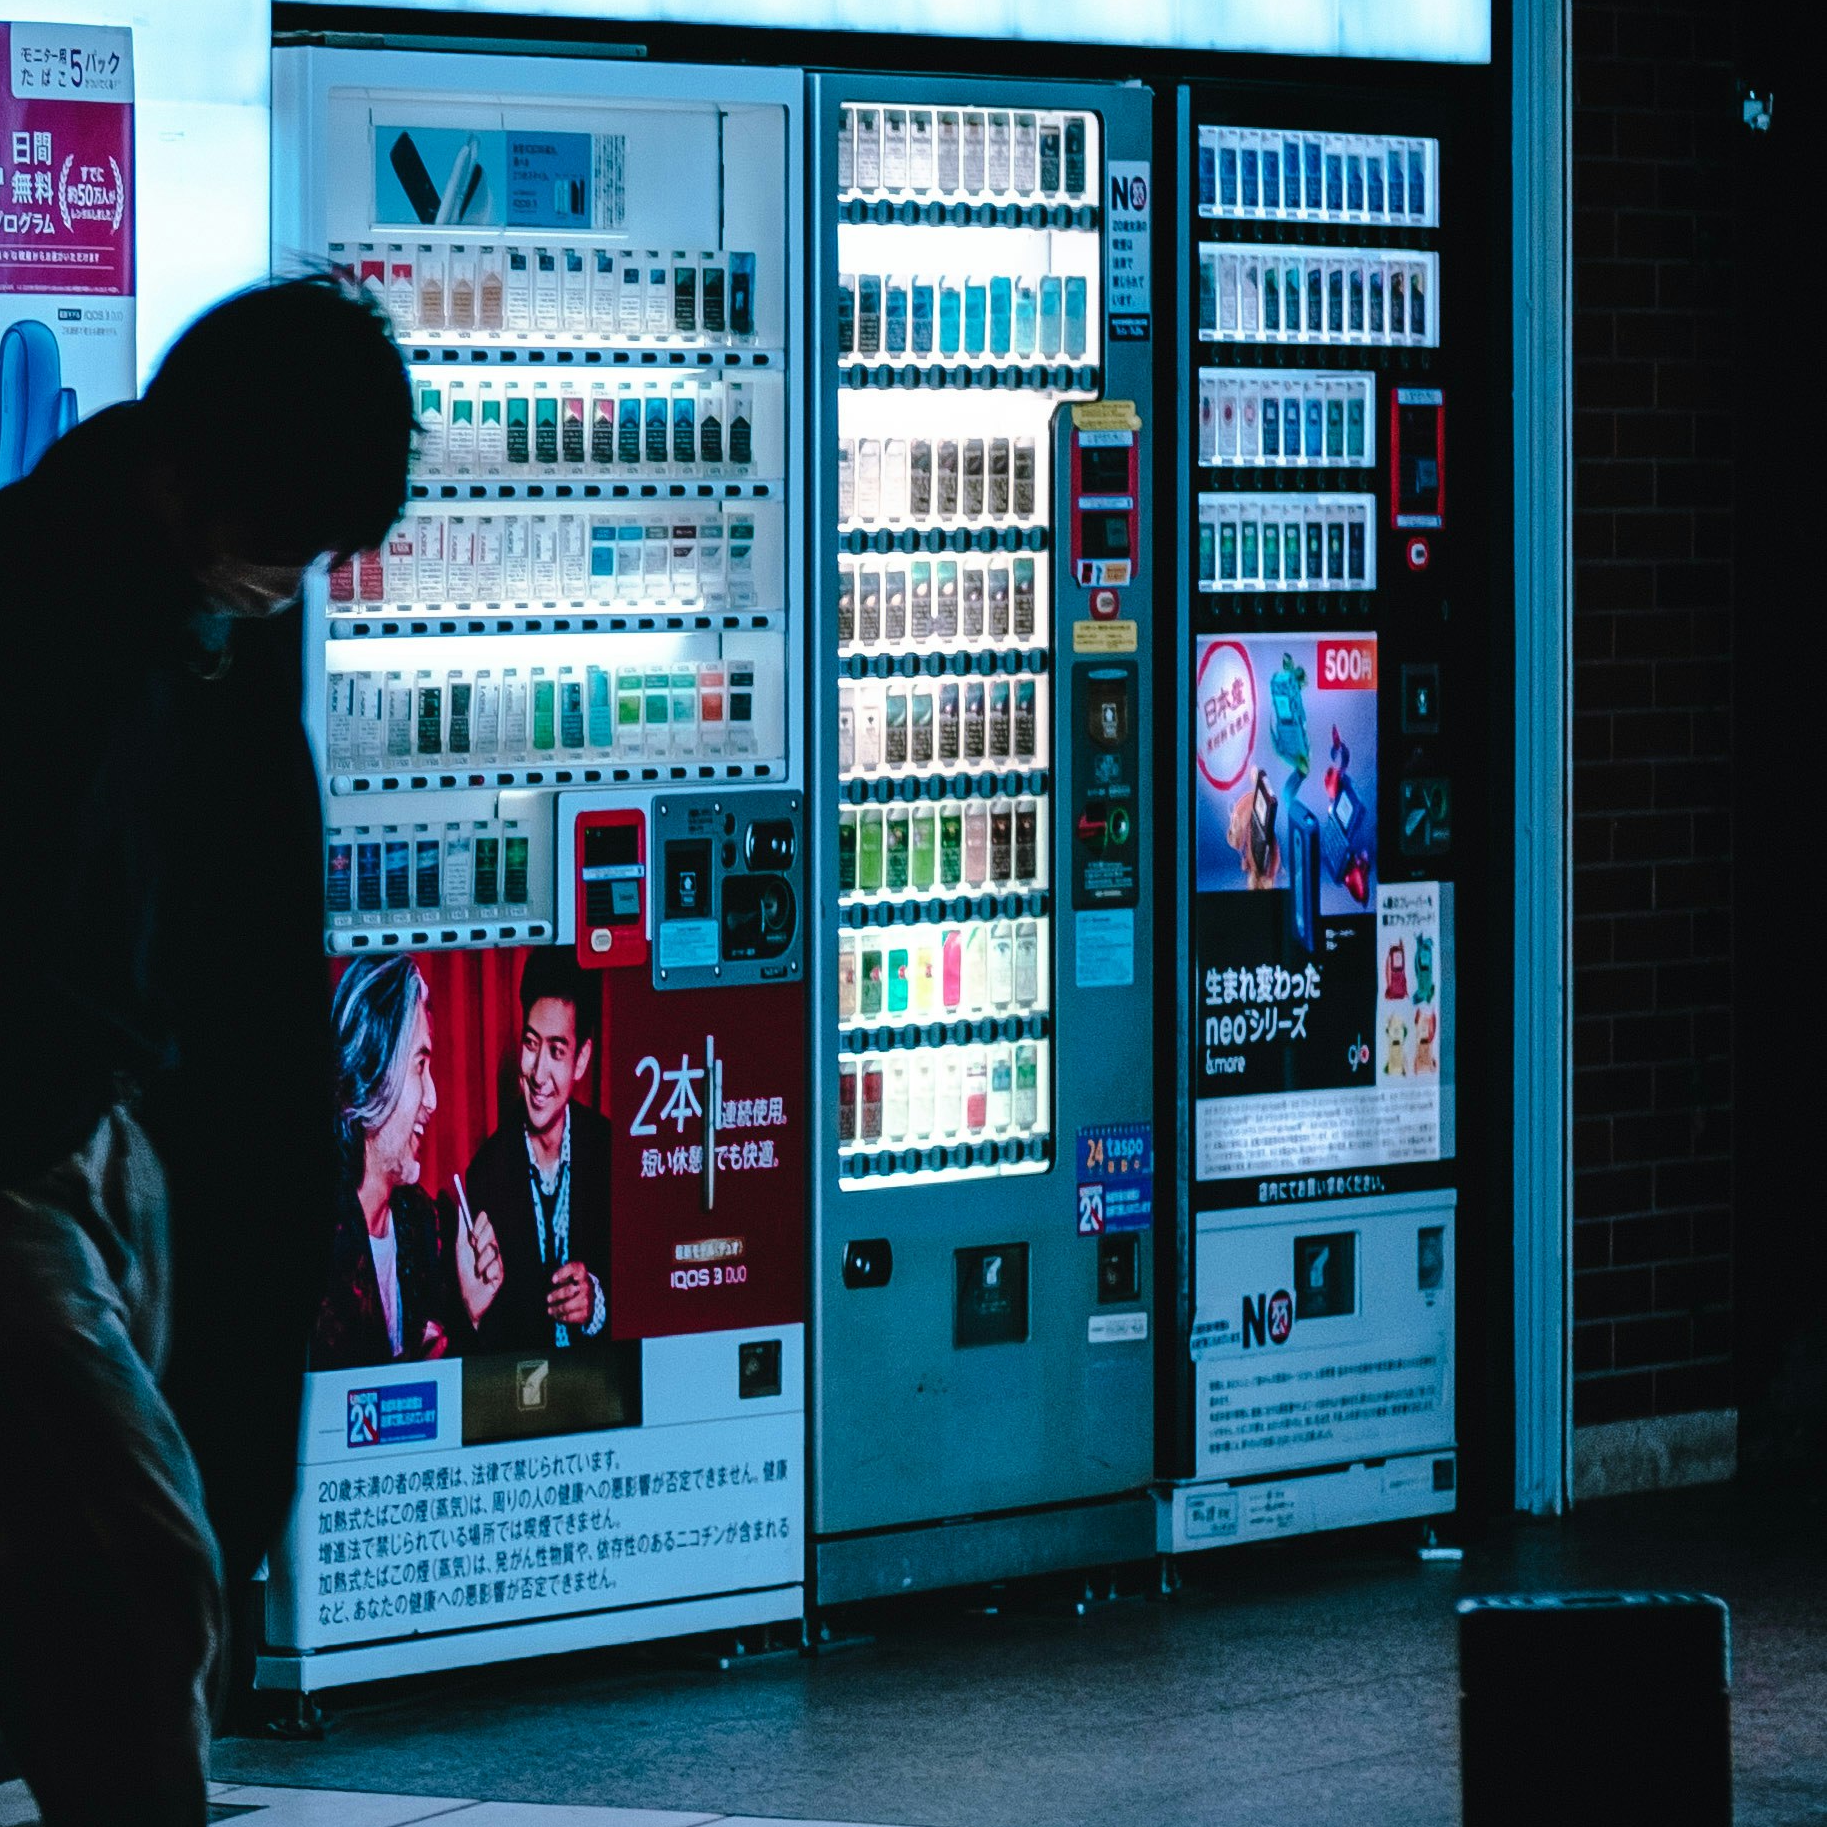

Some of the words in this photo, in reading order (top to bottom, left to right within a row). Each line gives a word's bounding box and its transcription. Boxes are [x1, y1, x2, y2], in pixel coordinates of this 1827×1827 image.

[12, 130, 52, 166] 日間
[11, 170, 54, 206] 無料
[1205, 962, 1321, 1006] 生まれ変わった
[1105, 1136, 1145, 1160] taspo
[670, 1268, 711, 1291] IQOS
